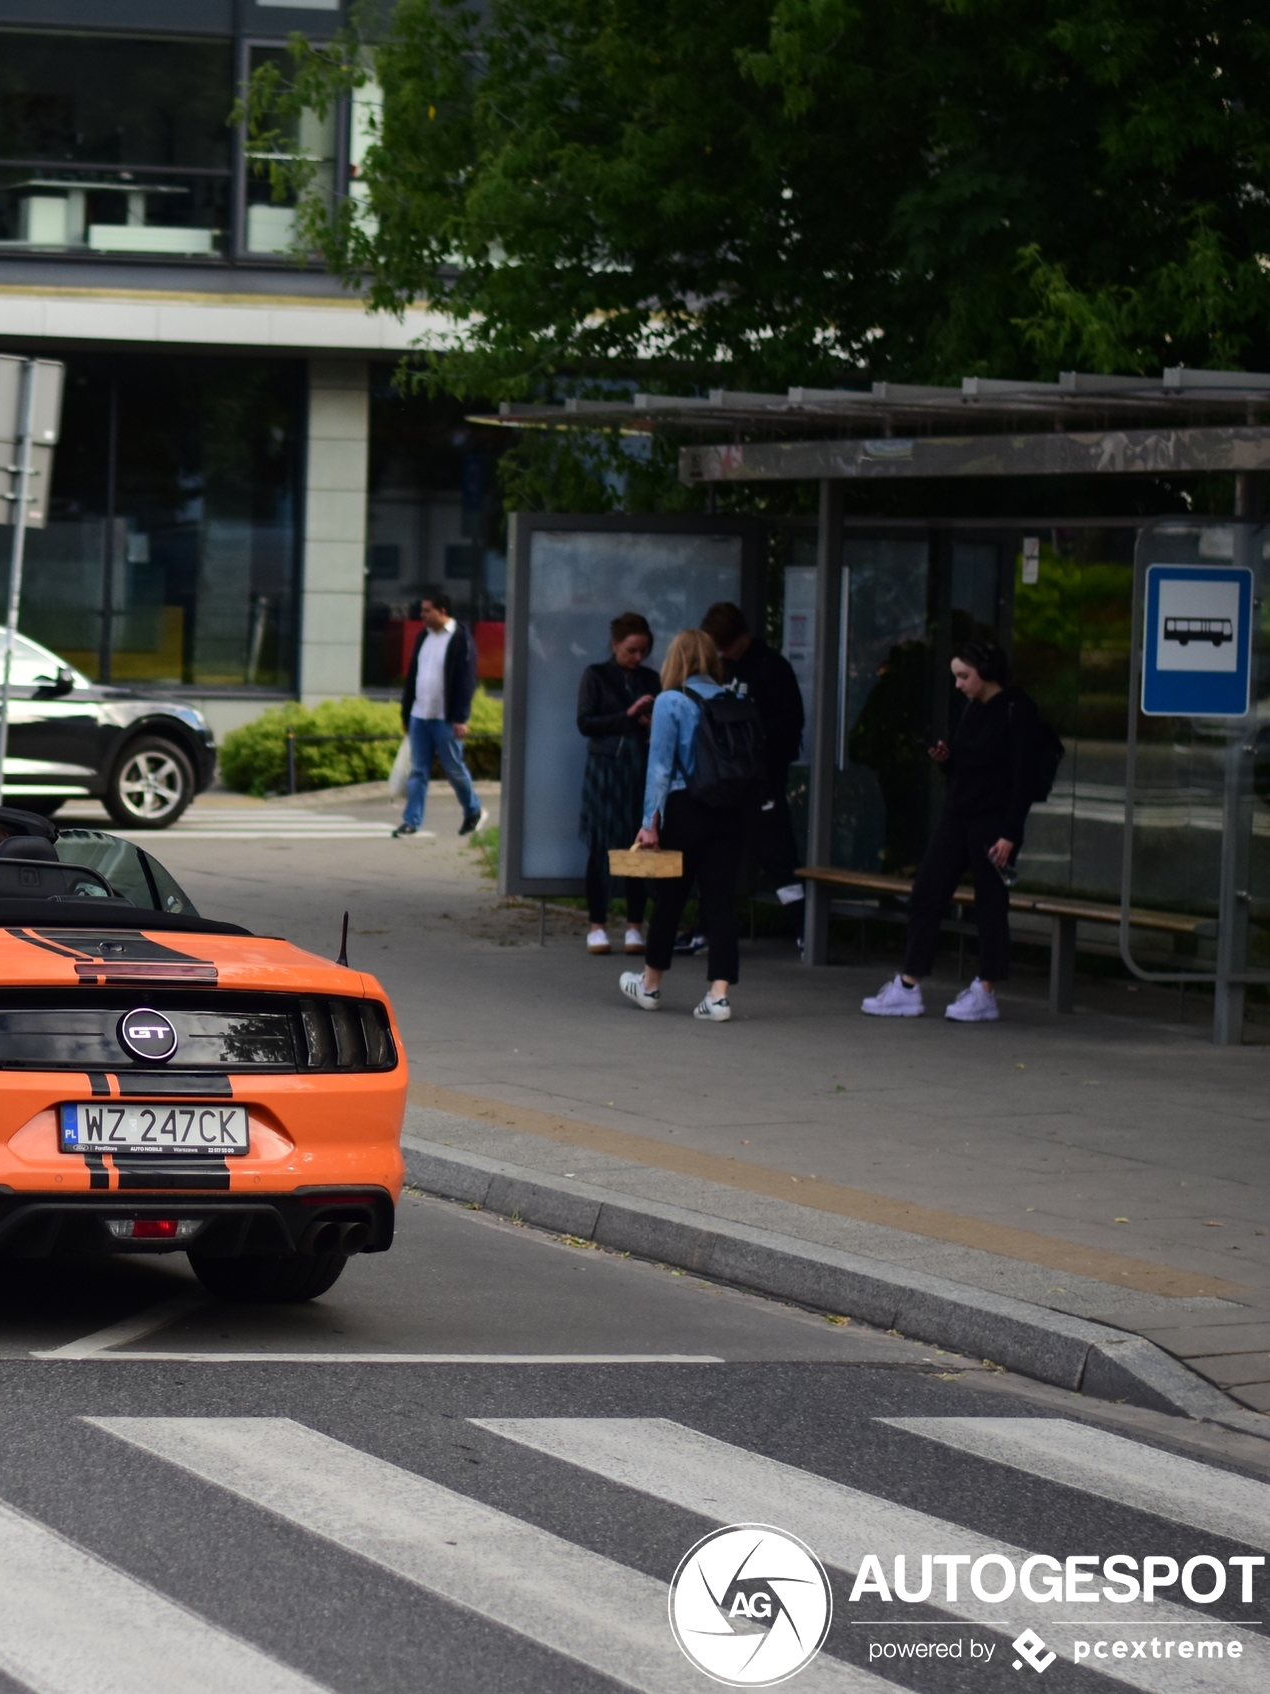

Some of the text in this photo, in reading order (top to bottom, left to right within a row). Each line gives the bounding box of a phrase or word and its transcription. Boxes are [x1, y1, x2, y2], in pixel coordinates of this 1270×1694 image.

[128, 1026, 170, 1039] GT
[85, 1108, 238, 1144] WZ 247CK
[65, 1129, 77, 1139] PL
